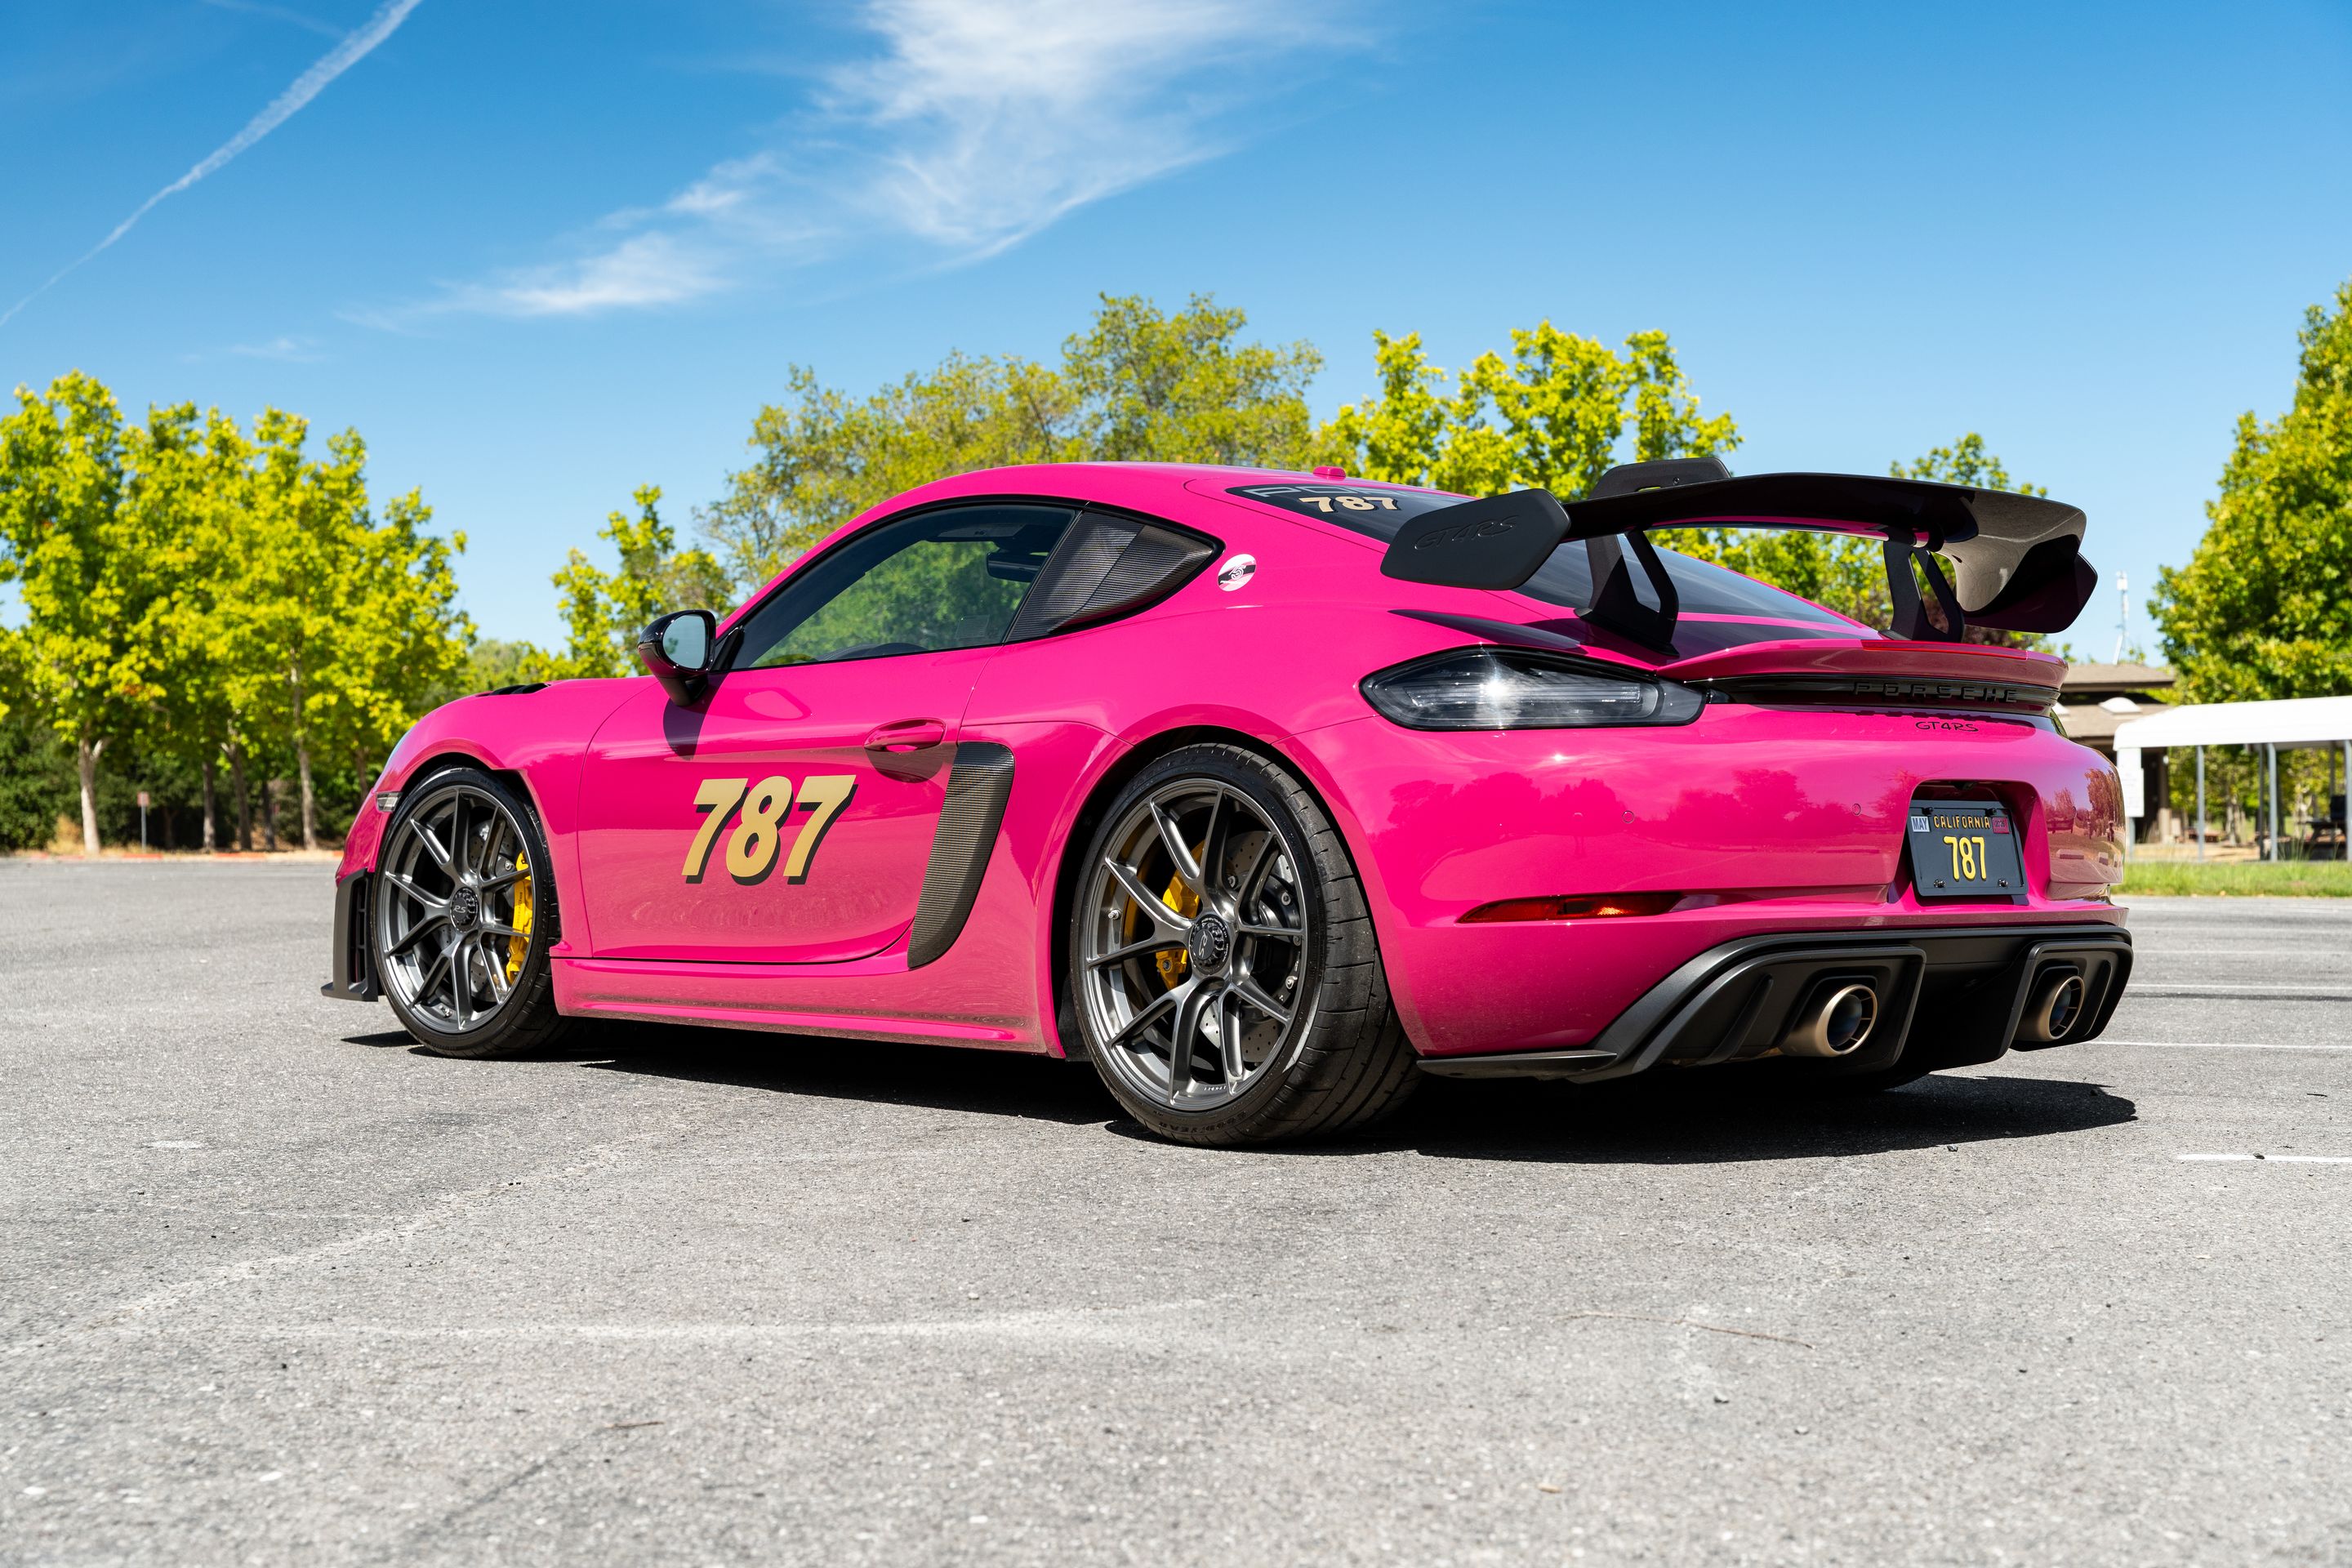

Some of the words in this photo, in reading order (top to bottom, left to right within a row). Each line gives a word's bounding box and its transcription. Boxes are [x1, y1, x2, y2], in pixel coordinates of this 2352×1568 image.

[1298, 496, 1401, 514] 787
[1414, 514, 1519, 550] GT4RS
[1854, 681, 2018, 703] PORSCHE
[1915, 721, 1980, 733] GT4RS
[681, 774, 859, 887] 787
[1912, 817, 1928, 831] MAY
[1933, 815, 1991, 830] CALIFORNIA
[1944, 835, 1987, 881] 787
[452, 905, 467, 914] RS
